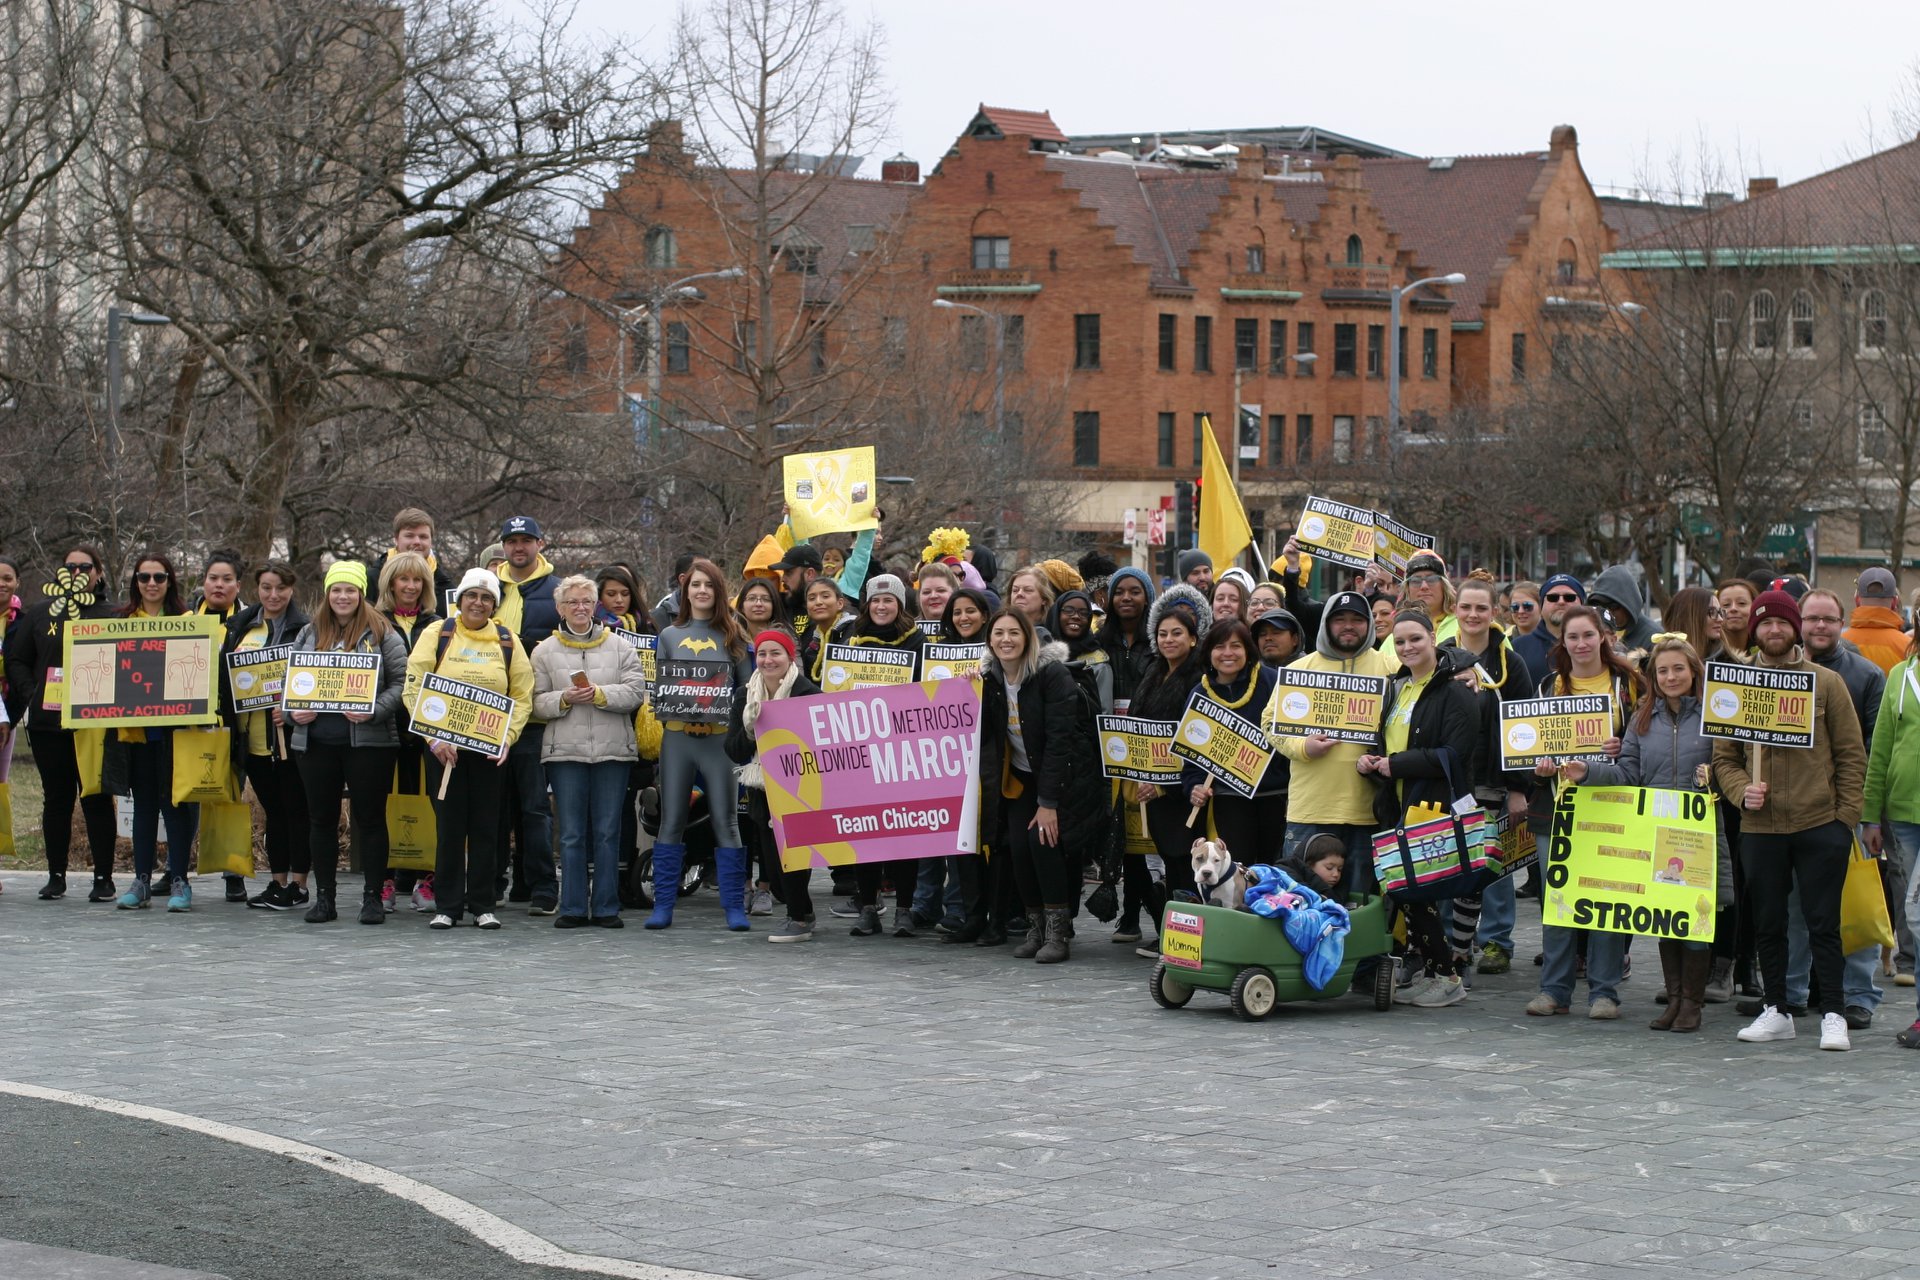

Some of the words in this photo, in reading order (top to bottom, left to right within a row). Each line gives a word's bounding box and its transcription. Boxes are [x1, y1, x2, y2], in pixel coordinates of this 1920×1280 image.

[1329, 519, 1355, 534] SEVERE
[1376, 514, 1428, 549] ENDOMETRIOSIS
[1327, 530, 1352, 542] PERIOD
[1326, 538, 1346, 551] PAIN?
[1316, 548, 1330, 556] END
[1344, 557, 1368, 566] SILENCE
[117, 640, 136, 652] WE
[141, 640, 166, 651] ARE
[295, 654, 373, 668] ENDOMETRIOSIS
[832, 647, 908, 666] ENDOMETRIOSIS
[318, 670, 345, 679] SEVERE
[672, 665, 686, 677] in
[692, 666, 707, 677] 10
[854, 673, 883, 682] DIAGNOSTIC
[884, 675, 907, 683] DELAYS?
[1714, 666, 1808, 690] ENDOMETRIOSIS
[317, 680, 343, 689] PERIOD
[347, 674, 371, 688] NOT
[1285, 671, 1377, 693] ENDOMETRIOSIS
[319, 689, 339, 698] PAIN?
[429, 676, 507, 710] ENDOMETRIOSIS
[657, 685, 732, 697] SUPERHEROES
[1313, 690, 1345, 704] SEVERE
[1742, 688, 1776, 703] SEVERE
[242, 695, 273, 706] SOMETHING
[450, 699, 478, 714] SEVERE
[1348, 698, 1375, 715] NOT
[1508, 698, 1603, 717] ENDOMETRIOSIS
[1779, 697, 1807, 715] NOT
[656, 702, 674, 713] Has
[676, 702, 731, 715] Endometriosis
[1313, 702, 1344, 715] PERIOD
[1742, 702, 1774, 715] PERIOD
[448, 709, 475, 724] PERIOD
[478, 710, 503, 729] NOT
[808, 698, 891, 746] ENDO
[892, 702, 974, 734] METRIOSIS
[1314, 714, 1339, 726] PAIN?
[1346, 714, 1373, 723] NORMAL!
[1539, 717, 1571, 729] SEVERE
[1744, 714, 1770, 726] PAIN?
[1777, 715, 1806, 724] NORMAL!
[447, 720, 470, 733] PAIN?
[1104, 718, 1173, 737] ENDOMETRIOSIS
[1195, 699, 1269, 750] ENDOMETRIOSIS
[1575, 719, 1603, 736] NOT
[414, 724, 427, 733] TIME
[437, 730, 452, 739] END
[453, 734, 467, 744] THE
[468, 738, 498, 752] SILENCE
[1214, 726, 1241, 748] SEVERE
[1341, 732, 1375, 740] SILENCE
[1540, 728, 1572, 740] PERIOD
[1576, 736, 1604, 745] NORMAL!
[1734, 728, 1751, 737] END
[1753, 730, 1769, 740] THE
[1772, 734, 1808, 744] SILENCE
[1127, 736, 1149, 748] SEVERE
[1211, 737, 1236, 757] PERIOD
[1544, 740, 1569, 752] PAIN?
[1128, 747, 1150, 758] PERIOD
[1209, 748, 1230, 765] PAIN?
[1238, 745, 1263, 769] NOT
[780, 745, 870, 777] WORLDWIDE
[1131, 758, 1148, 768] PAIN?
[1189, 751, 1196, 759] TO
[1196, 755, 1210, 768] END
[1211, 764, 1224, 776] THE
[1224, 772, 1250, 793] SILENCE
[1652, 791, 1679, 819] IN
[1683, 793, 1707, 821] 10
[832, 812, 879, 834] Team
[882, 808, 950, 831] Chicago
[1546, 787, 1577, 888] ENDO
[1574, 898, 1689, 938] STRONG
[1168, 937, 1200, 961] Mommy
